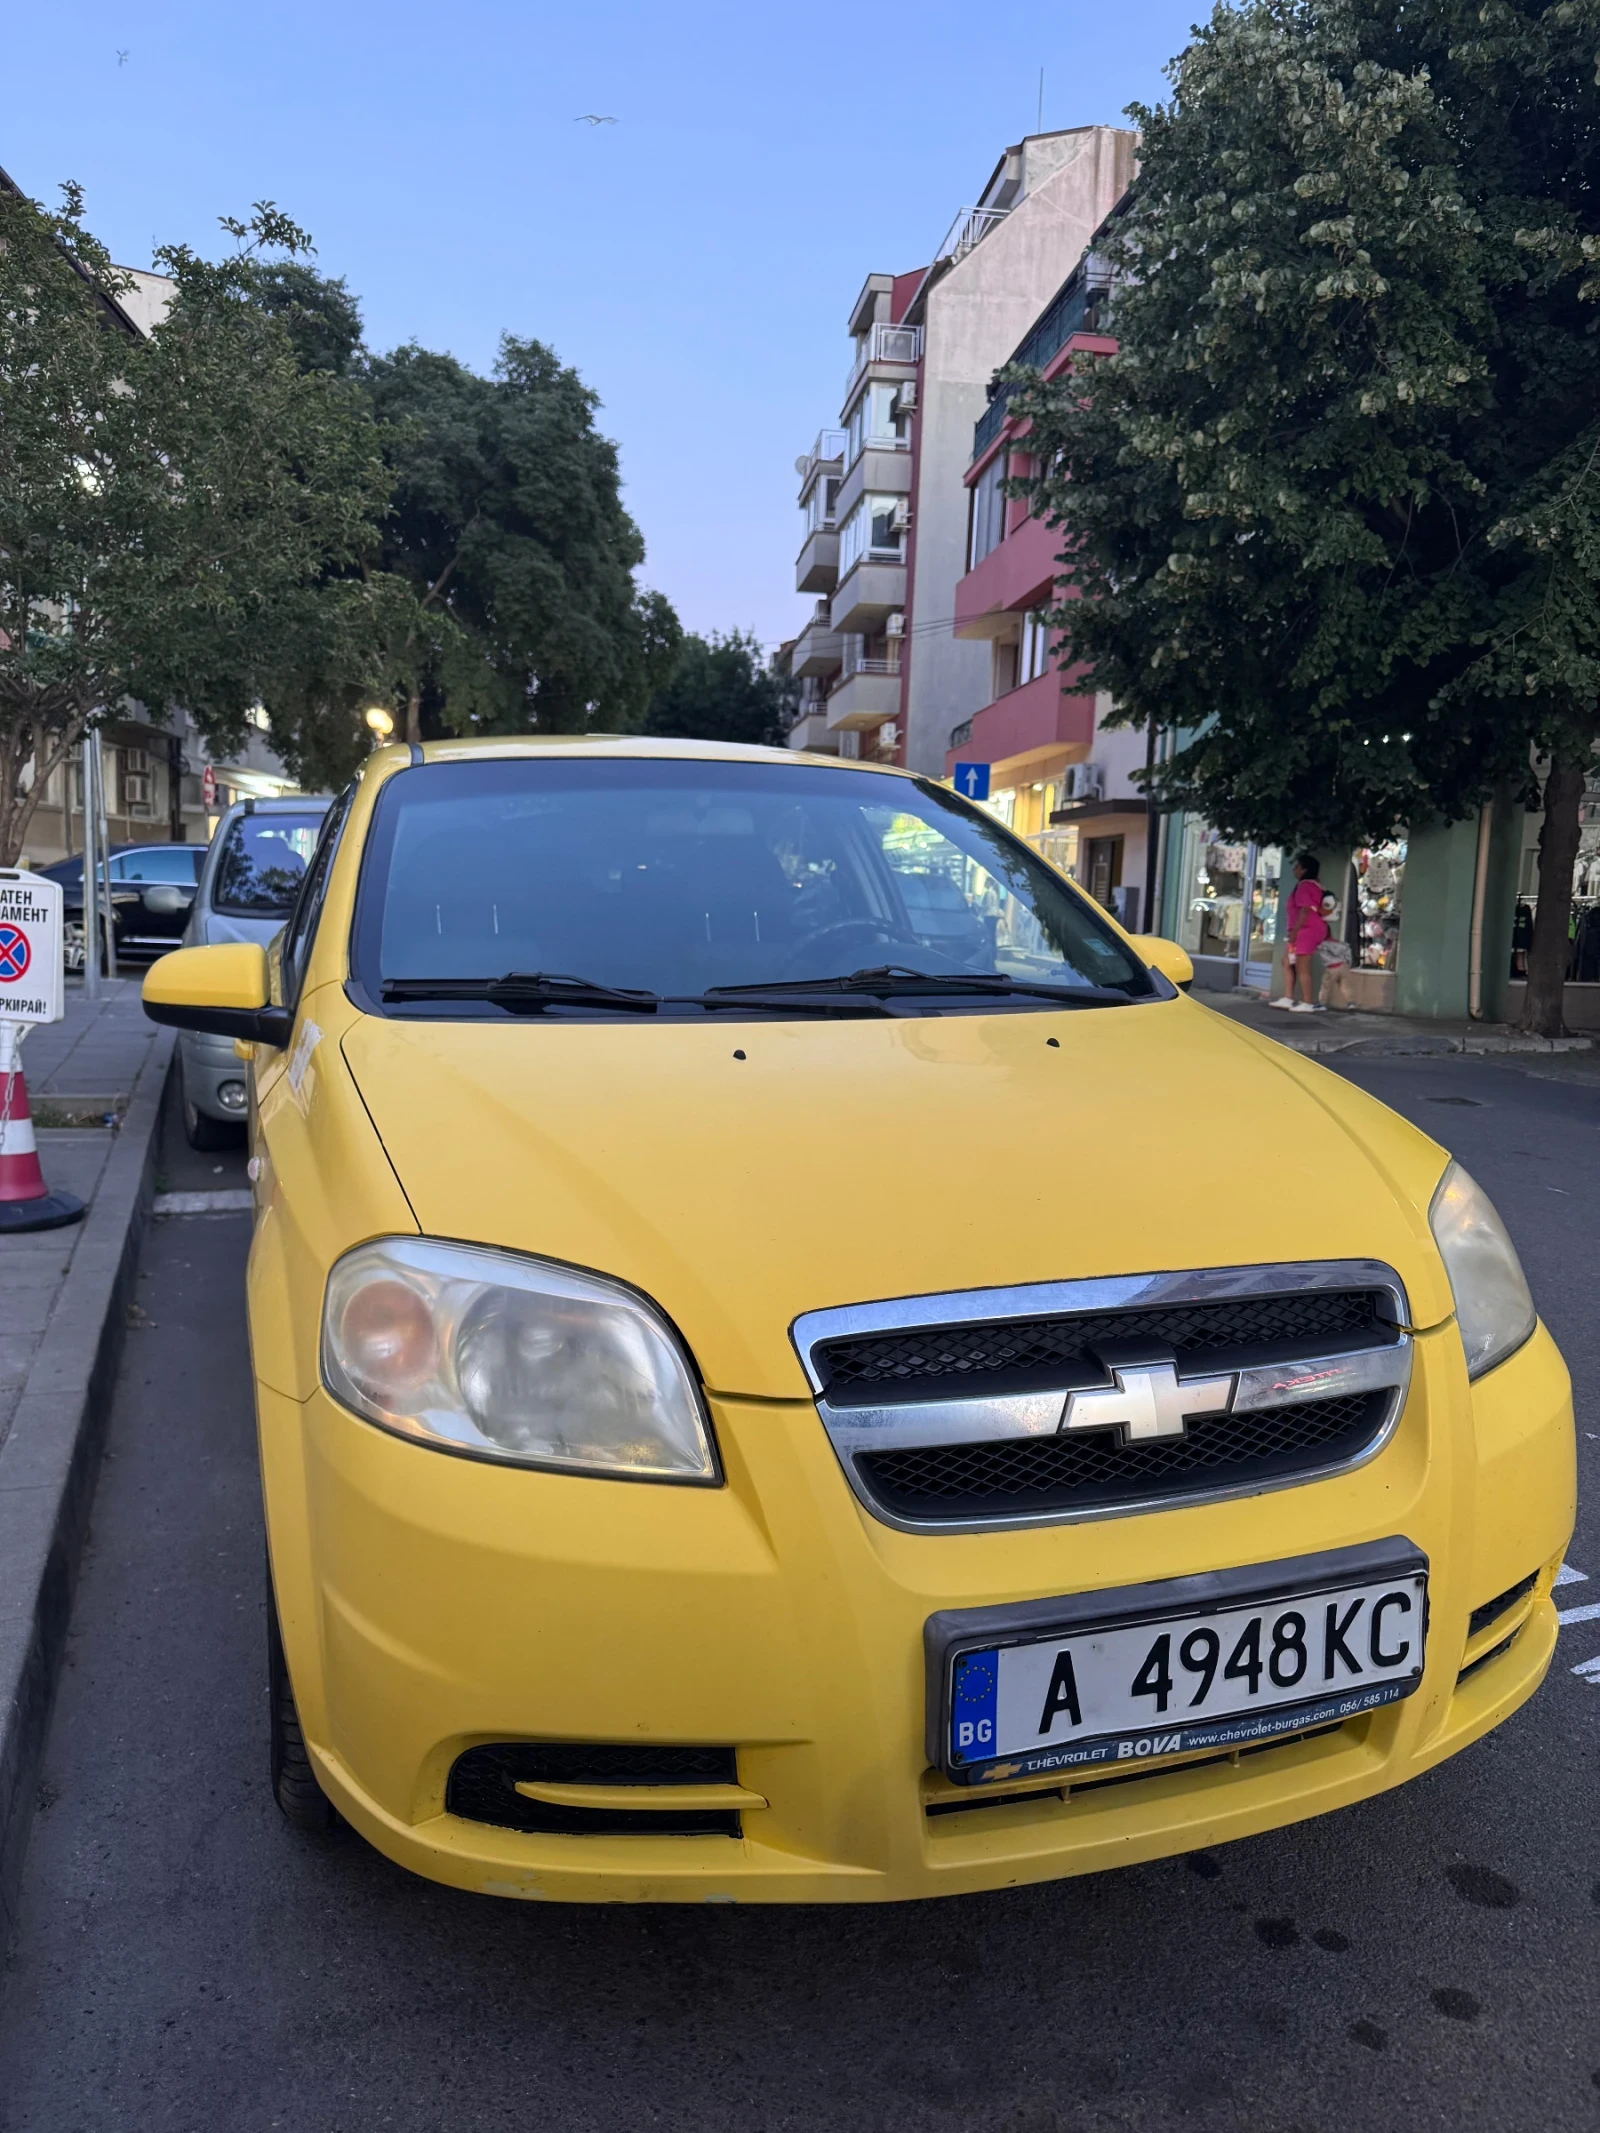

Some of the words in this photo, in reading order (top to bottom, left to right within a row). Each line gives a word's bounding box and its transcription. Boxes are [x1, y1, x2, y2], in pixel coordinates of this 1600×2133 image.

[0, 889, 32, 905] АТЕН
[1038, 1649, 1083, 1735] A
[1130, 1610, 1308, 1713] 4948
[959, 1718, 992, 1747] BG
[1027, 1748, 1108, 1771] CHEVROLET
[1117, 1734, 1181, 1759] BOVA
[1188, 1706, 1335, 1746] www.chevrolet-burgas.com
[1363, 1694, 1381, 1707] 585
[1383, 1687, 1400, 1701] 114
